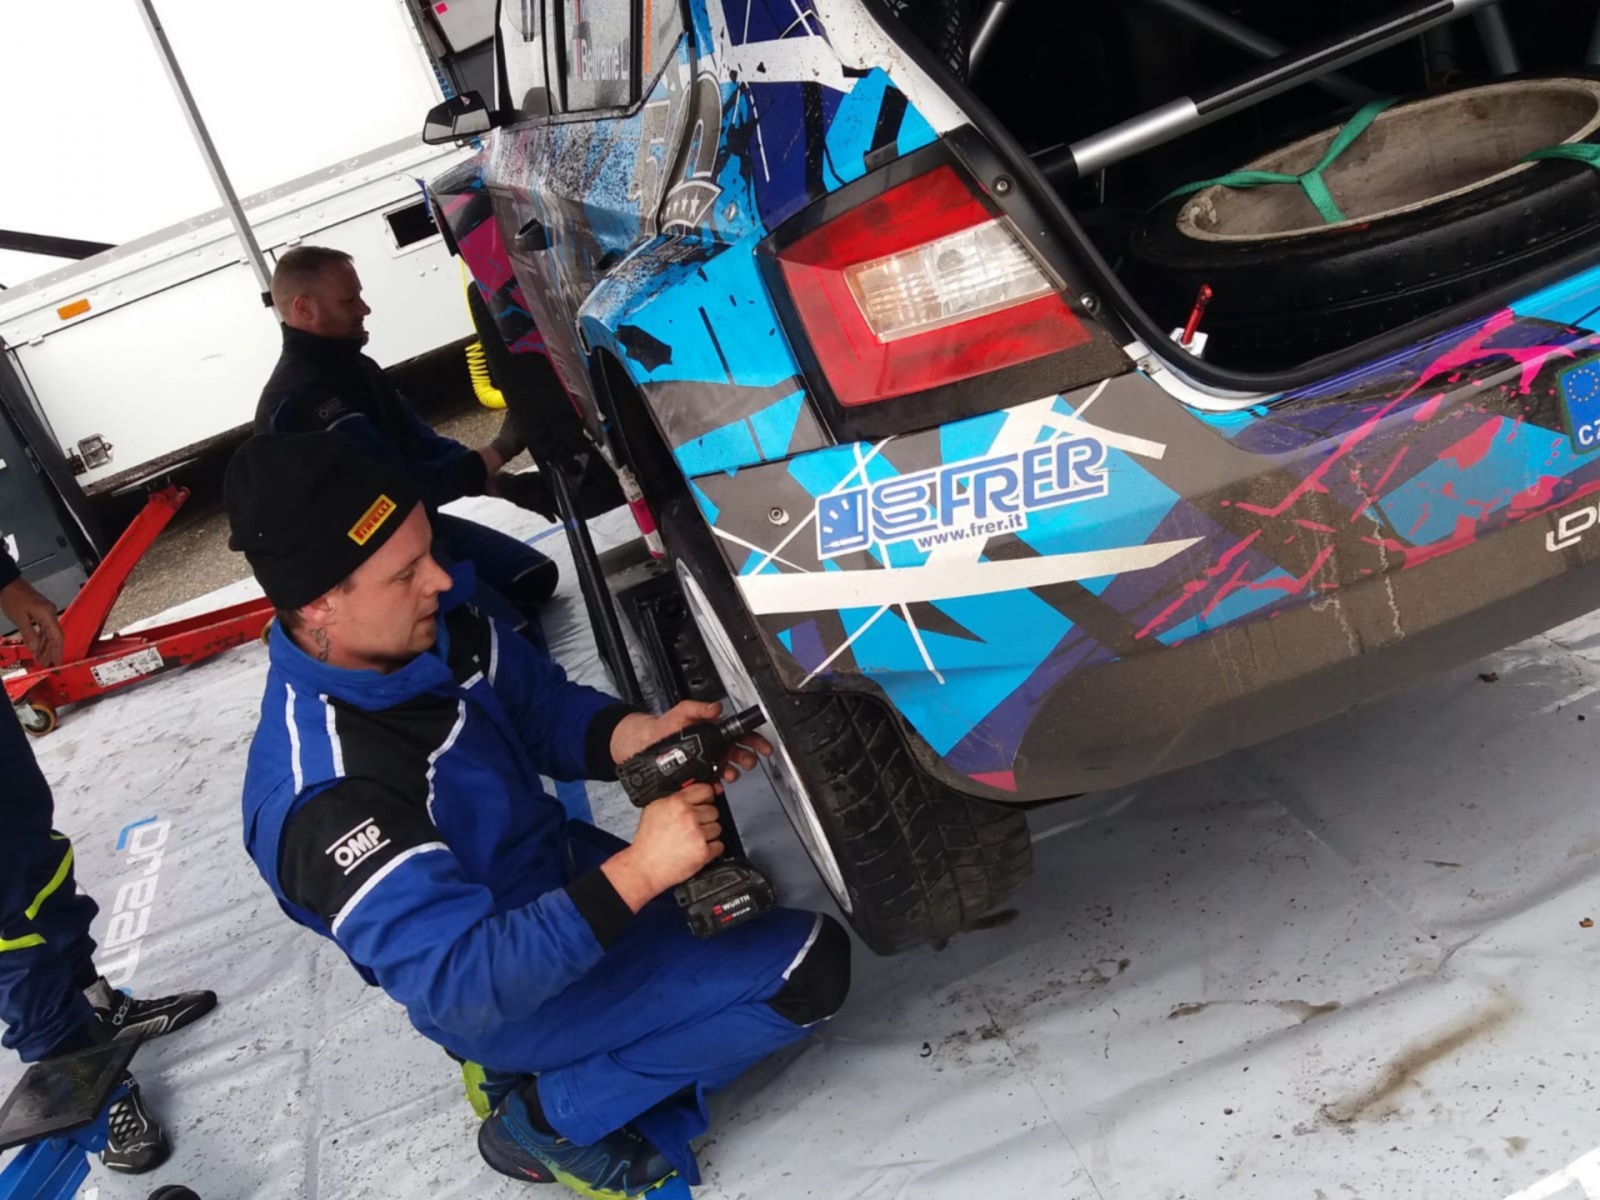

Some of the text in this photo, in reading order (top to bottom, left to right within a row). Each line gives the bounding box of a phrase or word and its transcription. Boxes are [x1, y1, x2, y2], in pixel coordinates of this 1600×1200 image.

[353, 499, 391, 540] PIRELLI
[918, 513, 1023, 549] www.frer.it
[334, 824, 381, 867] OMP
